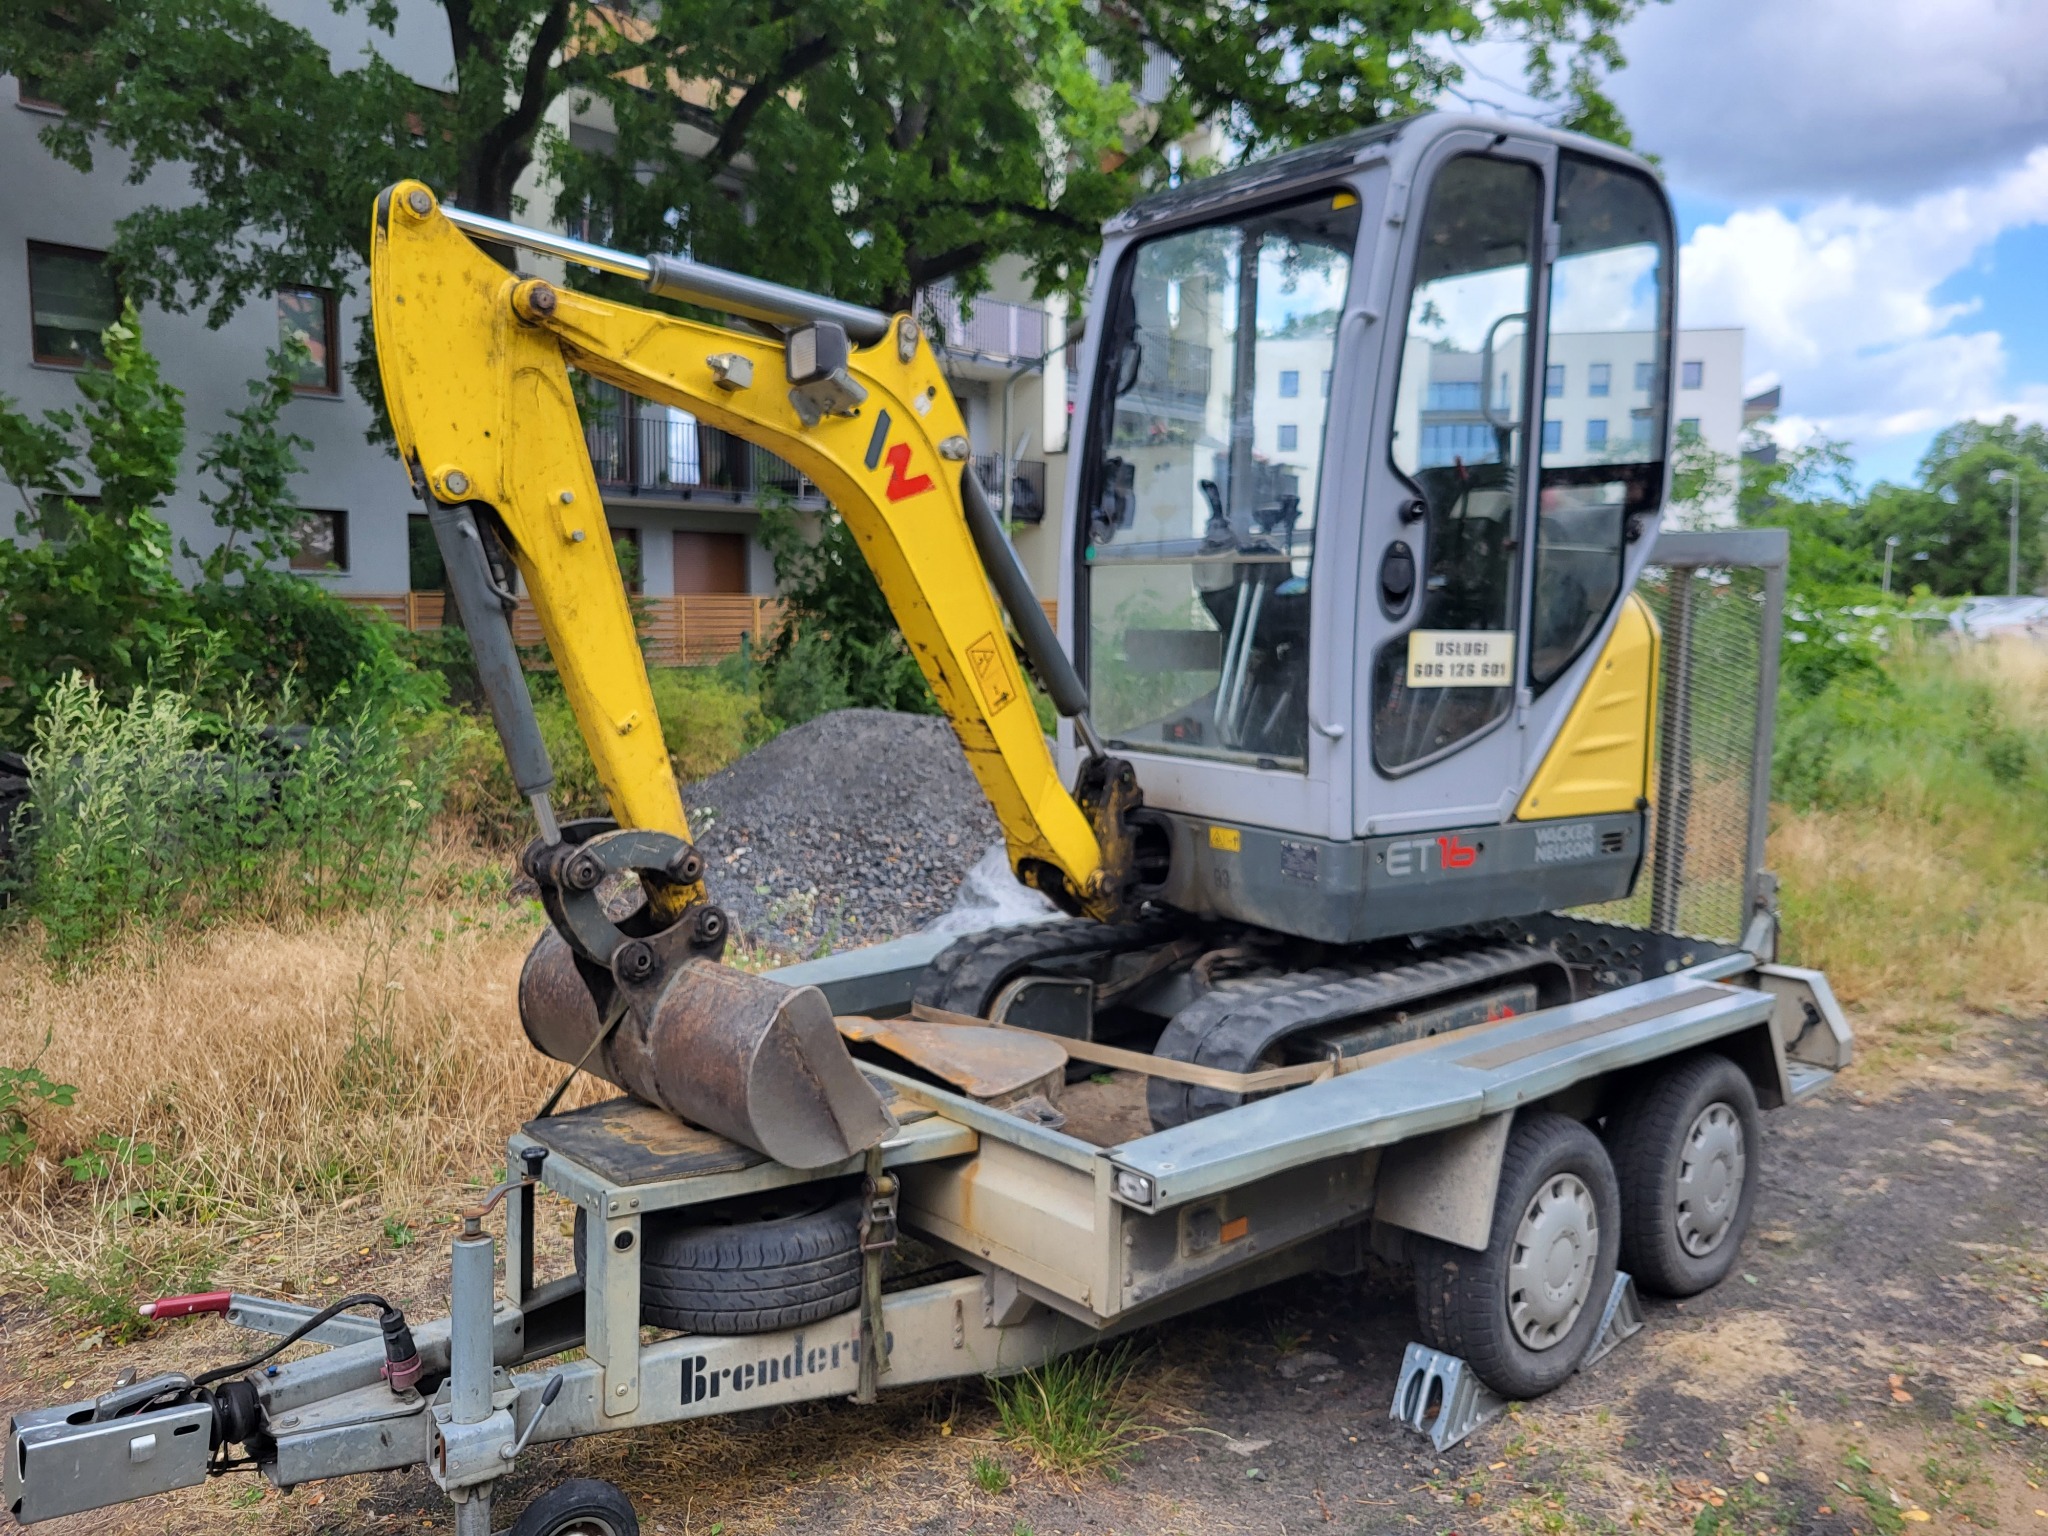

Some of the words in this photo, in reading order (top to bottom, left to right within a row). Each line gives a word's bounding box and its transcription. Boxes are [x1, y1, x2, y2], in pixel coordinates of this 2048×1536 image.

[1414, 663, 1444, 678] 606
[1450, 663, 1475, 677] 126
[1481, 663, 1506, 677] 601
[1386, 836, 1476, 877] ET16
